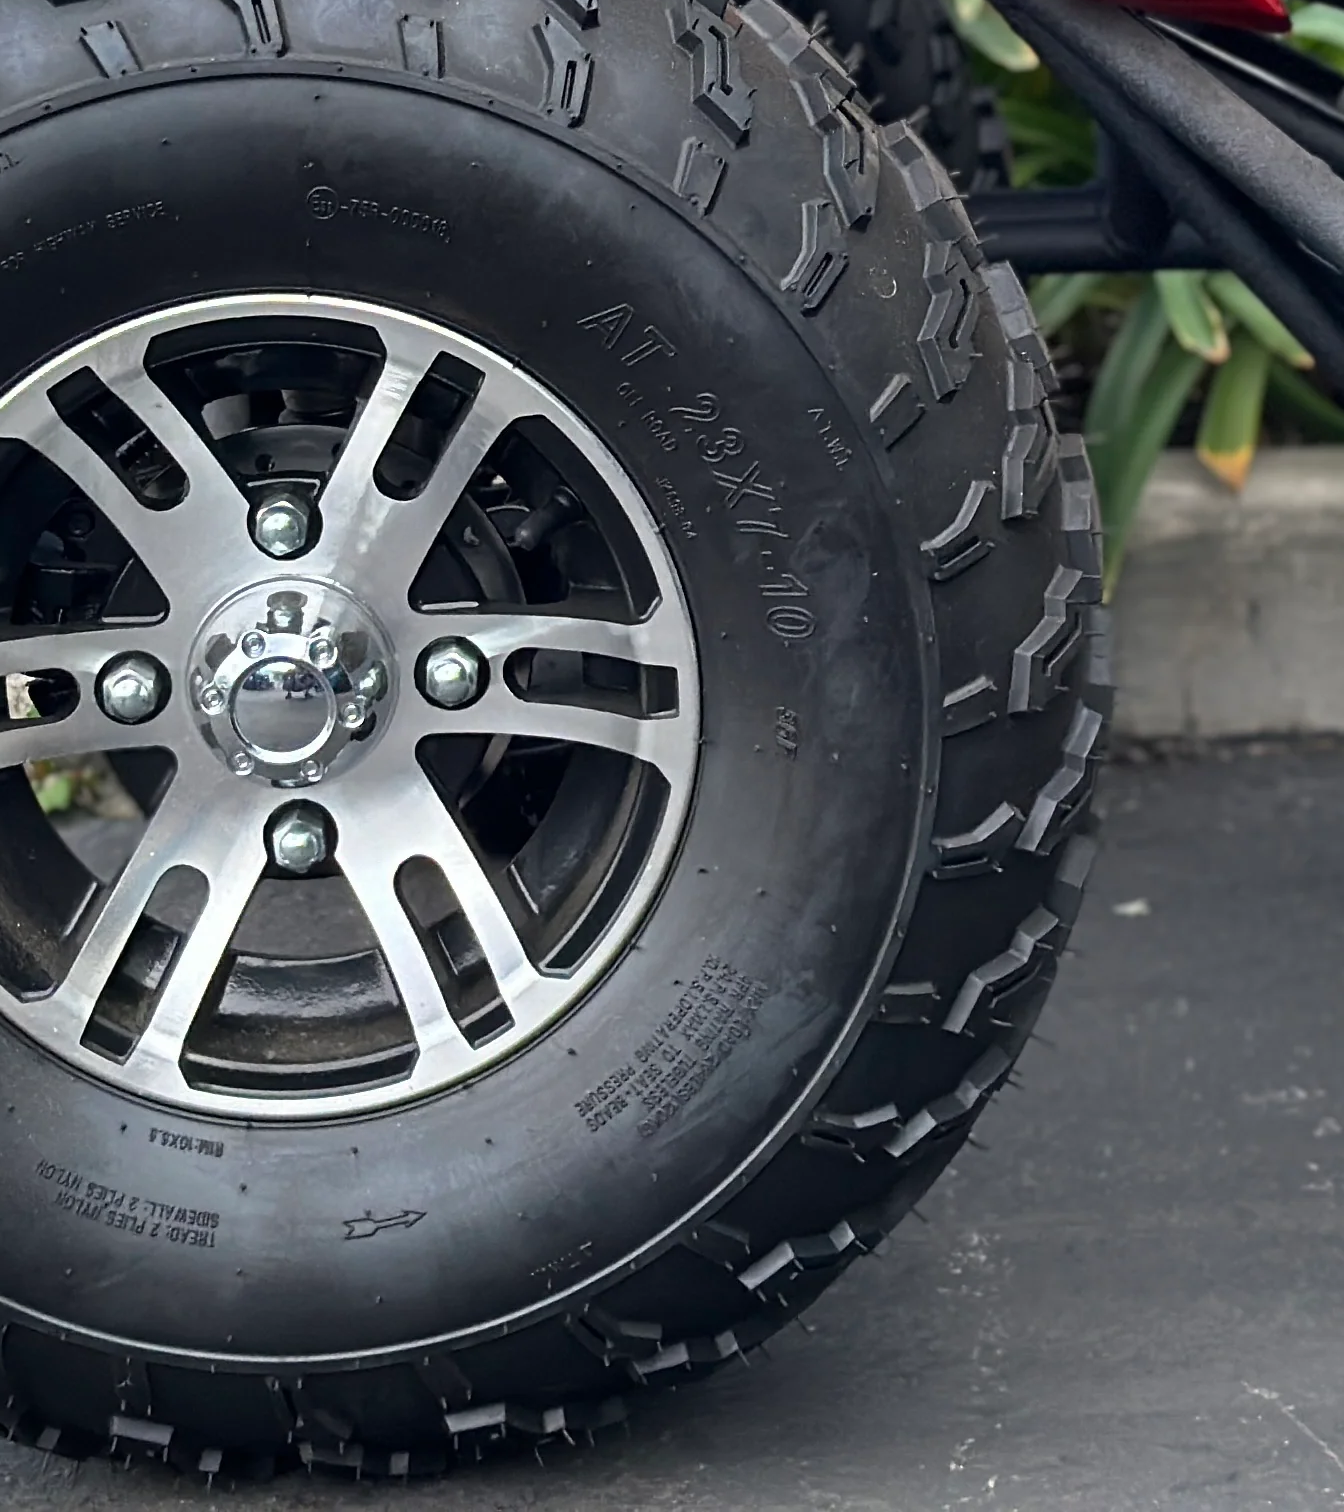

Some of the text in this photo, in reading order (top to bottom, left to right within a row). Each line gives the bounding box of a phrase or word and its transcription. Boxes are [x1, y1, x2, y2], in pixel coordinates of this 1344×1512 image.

[577, 302, 677, 367] AT
[662, 1044, 682, 1063] TO
[573, 1065, 637, 1118] PRESSURE
[35, 1159, 84, 1188] NYLON
[85, 1181, 126, 1208] PLIES
[129, 1195, 141, 1212] 2
[54, 1189, 217, 1248] TREAD: 2 PLIES NYLON
